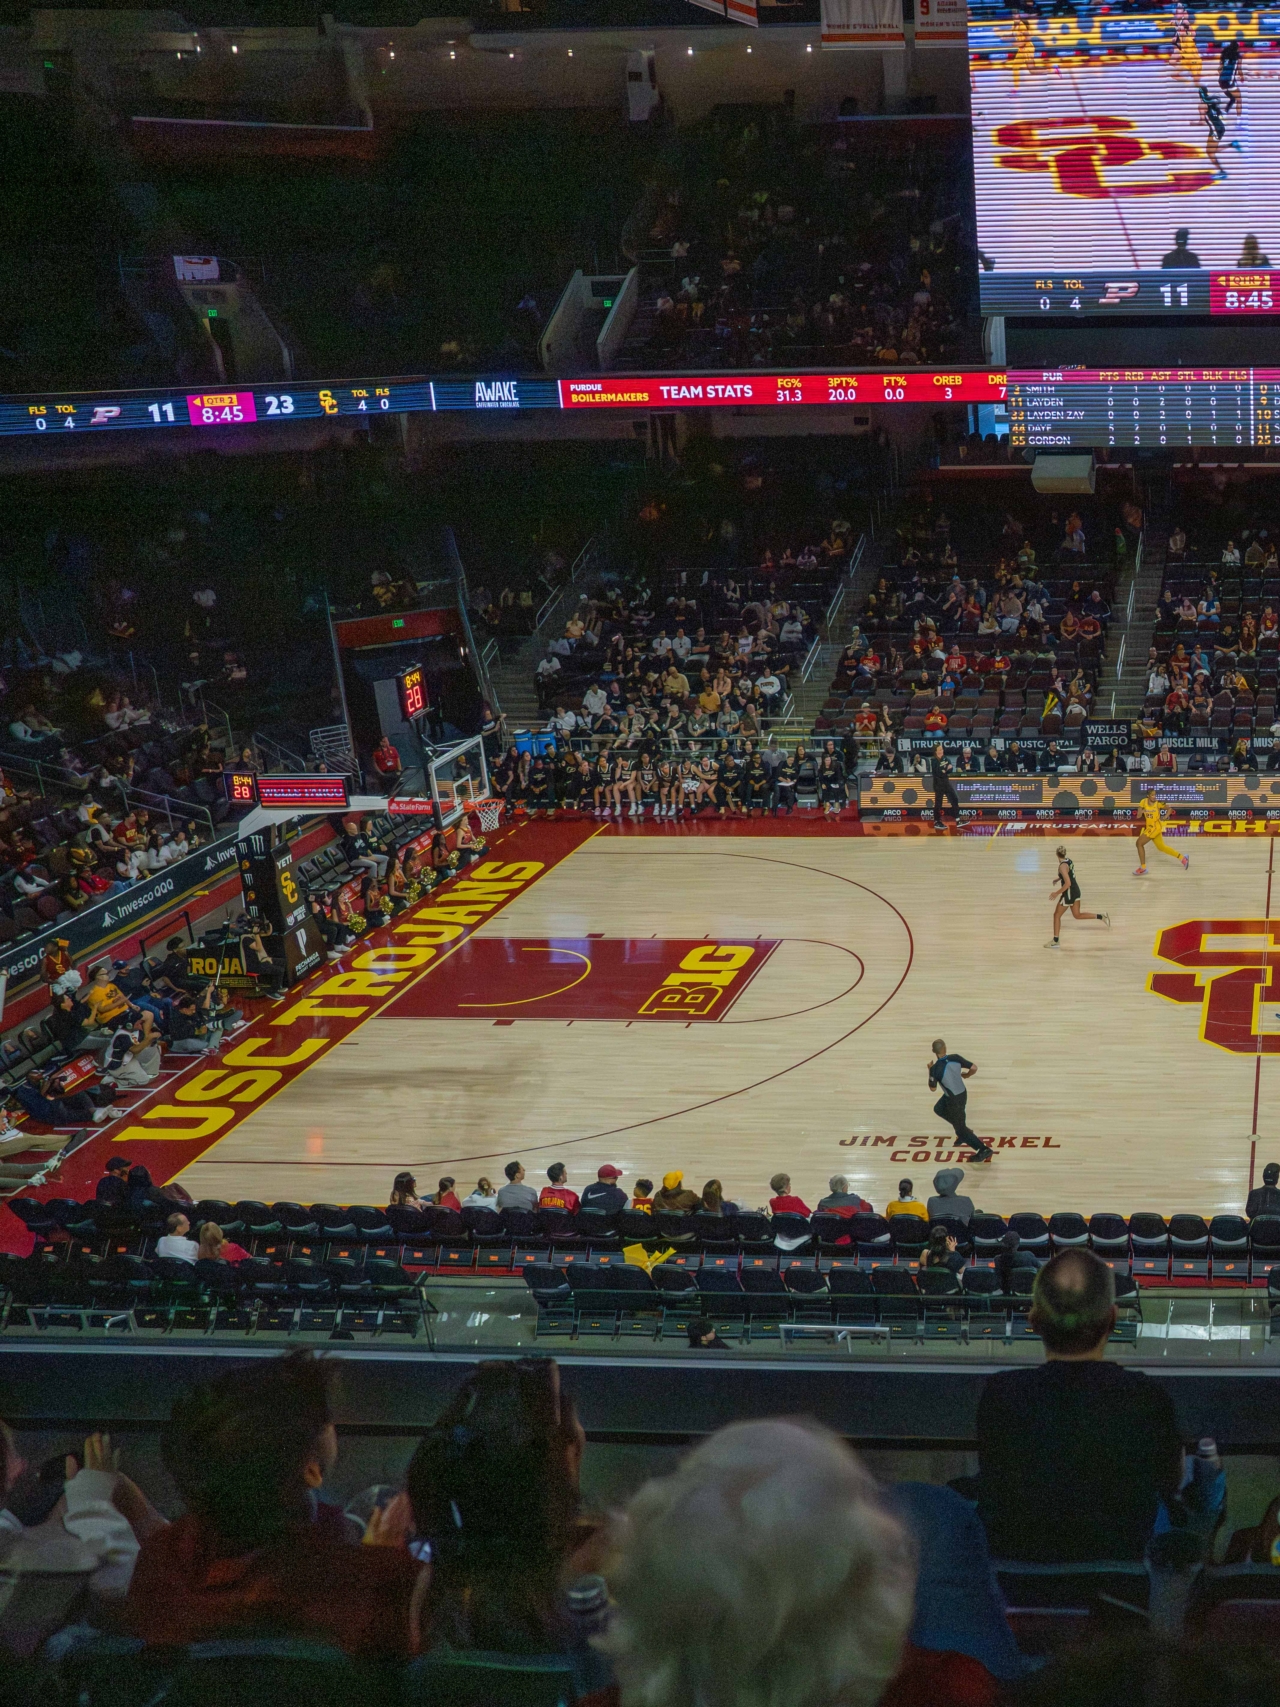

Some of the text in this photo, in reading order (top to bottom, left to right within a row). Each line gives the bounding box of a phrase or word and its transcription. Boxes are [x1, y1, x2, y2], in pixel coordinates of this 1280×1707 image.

[1036, 280, 1085, 290] FLS TOL
[1160, 284, 1188, 306] 11
[1226, 291, 1273, 310] 8:45
[1070, 297, 1082, 310] 4
[777, 374, 1006, 388] FG% 3PT% FT% OREB DRE
[352, 388, 390, 398] TOL FLS
[475, 382, 518, 402] AWAKE
[571, 392, 650, 402] BOILERMAKERS
[660, 384, 753, 400] TEAM STATS
[776, 388, 952, 402] 31.3 20.0 0.0 3
[28, 404, 77, 415] FLS TOL
[265, 396, 294, 414] 23
[358, 398, 389, 412] 4 0
[1026, 398, 1064, 407] LAYDEN
[148, 402, 175, 422] 11
[201, 406, 244, 423] 8:45
[1028, 410, 1085, 420] LAYDEN ZAY
[36, 416, 76, 430] 0 4
[1012, 436, 1071, 446] 55 GORDON
[406, 686, 422, 712] 28
[1086, 725, 1127, 734] WELLS
[912, 740, 982, 748] ITRUSTCAPITAL
[1087, 736, 1128, 746] FARGO
[1158, 738, 1218, 748] MUSCLE MILK
[233, 776, 252, 786] 8:44
[234, 786, 249, 798] 28
[276, 854, 293, 870] YETI
[117, 879, 174, 918] Invesco QQQ
[295, 952, 320, 972] PECHANGA
[111, 860, 545, 1142] USC TROJANS
[838, 1136, 898, 1148] JIM
